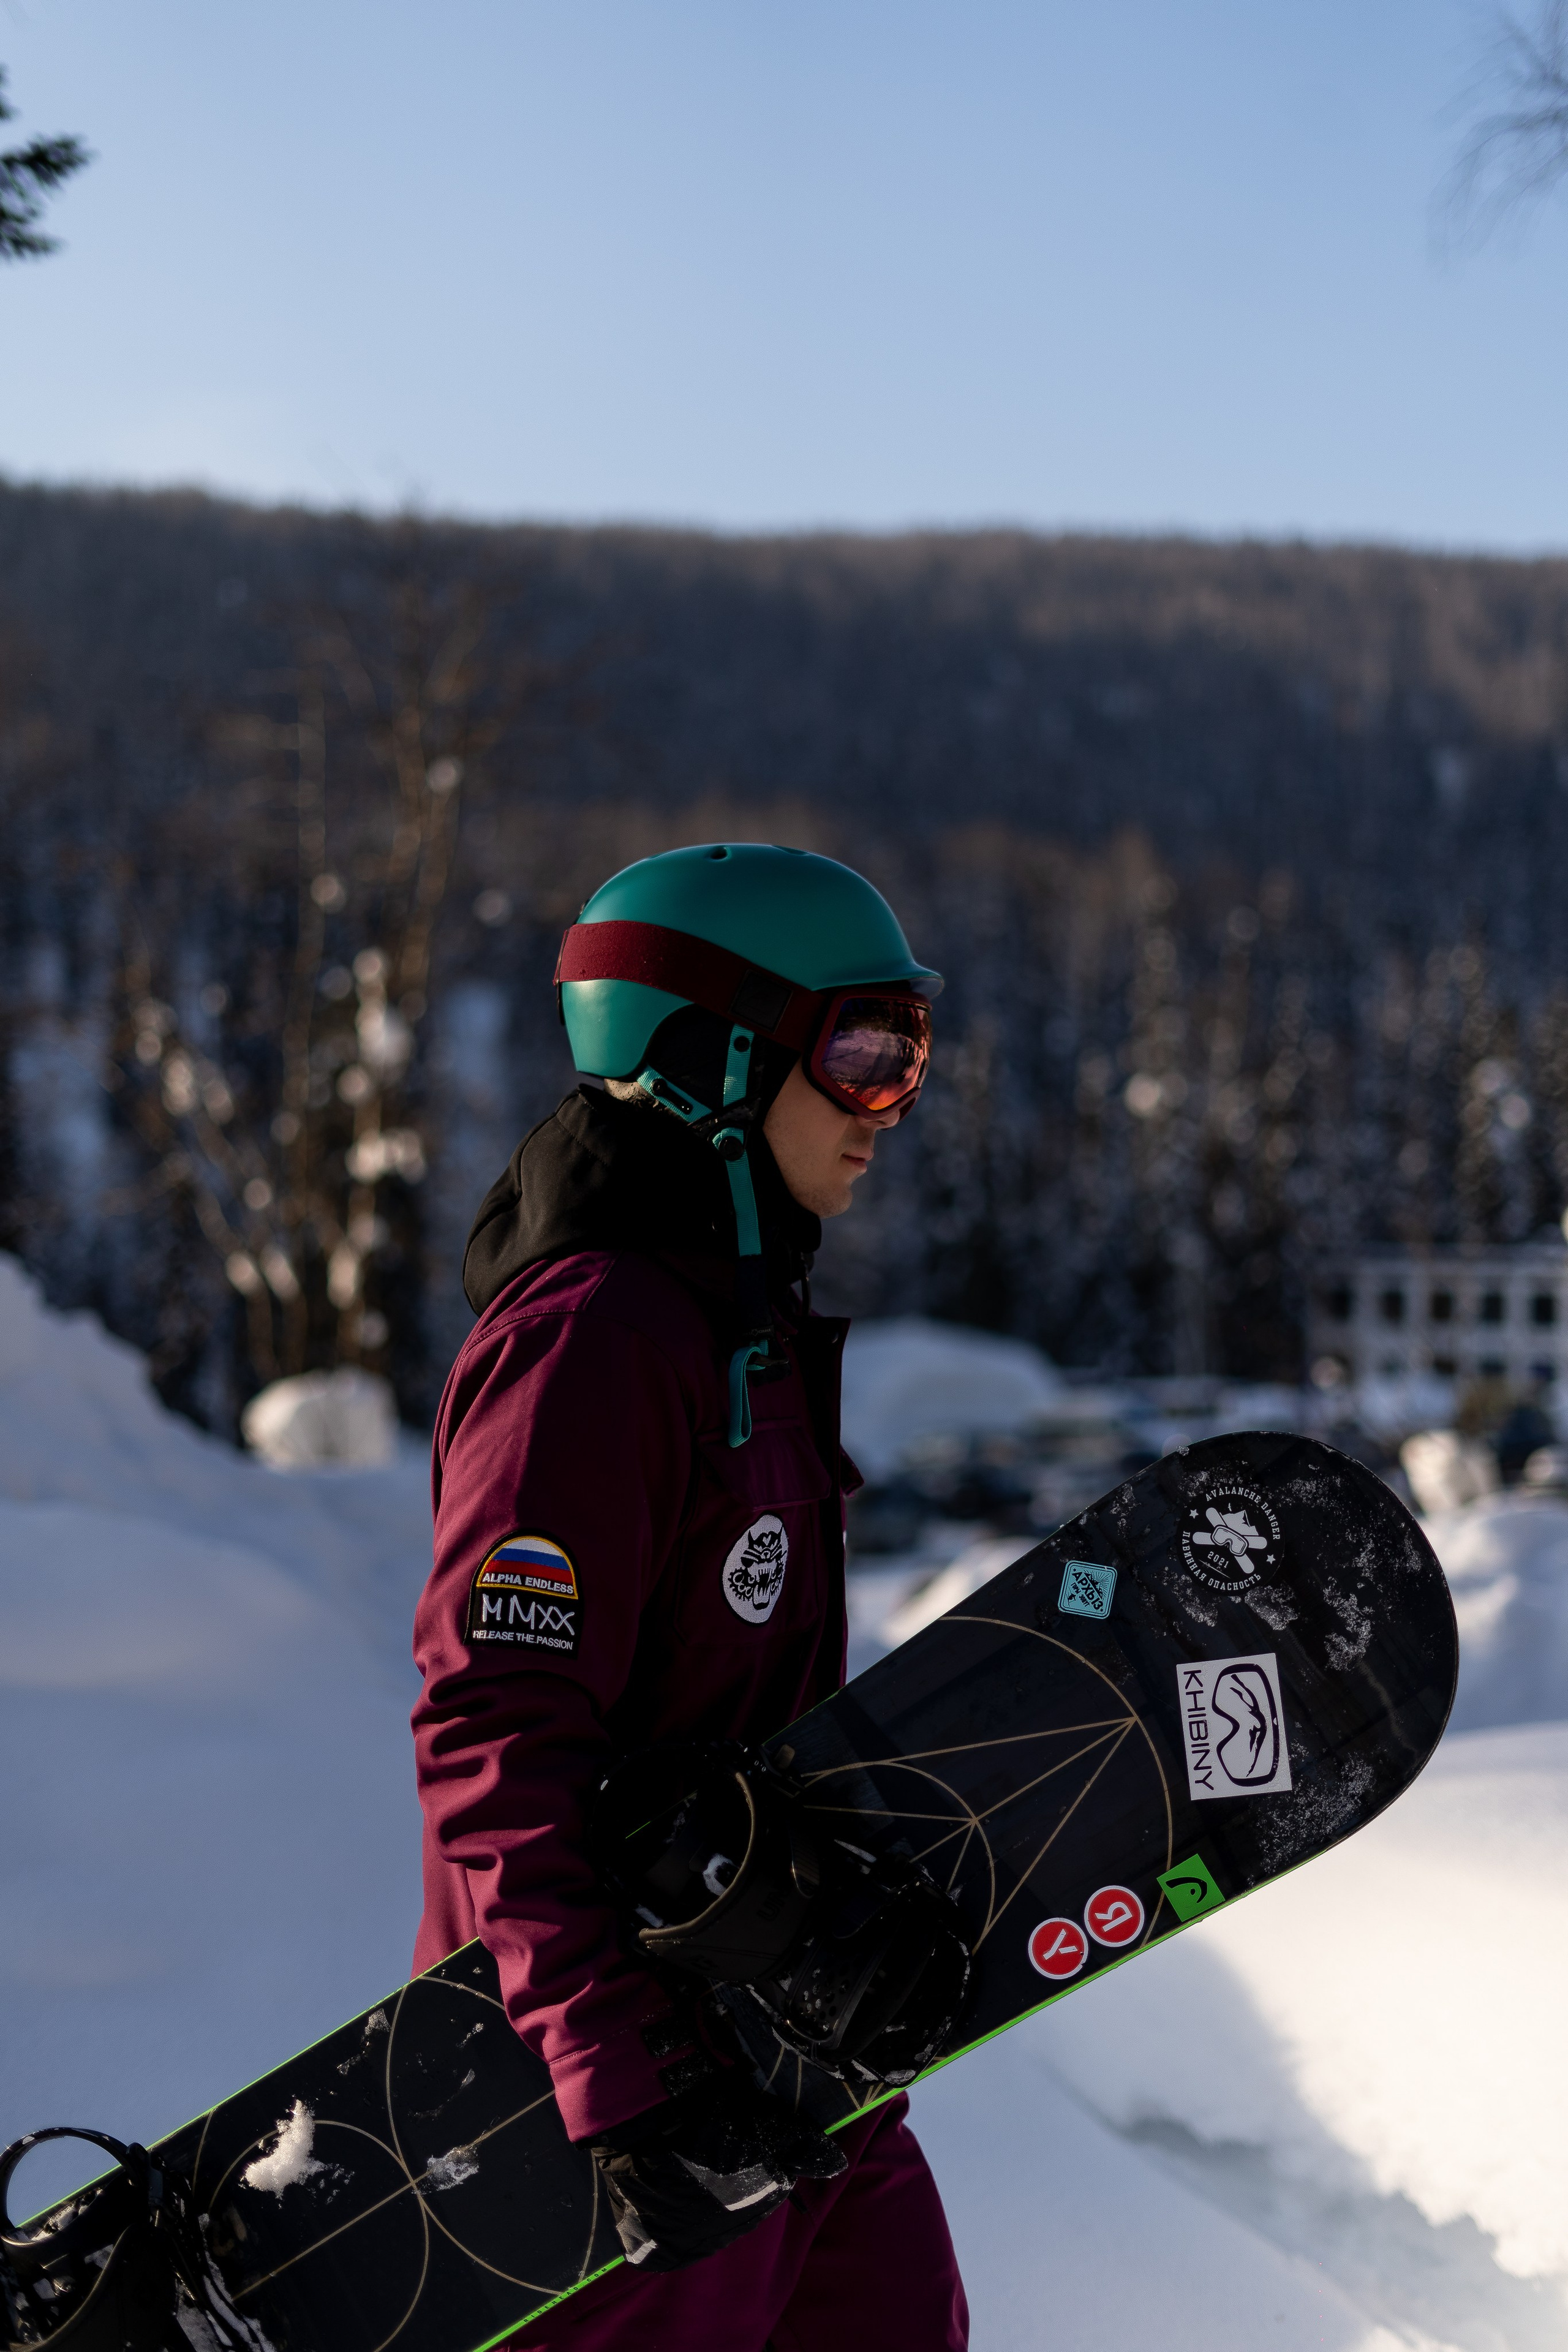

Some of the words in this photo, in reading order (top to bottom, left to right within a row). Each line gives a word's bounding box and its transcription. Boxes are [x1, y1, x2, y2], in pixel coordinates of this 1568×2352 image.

[1205, 1487, 1261, 1504] AVALANCHE
[1261, 1502, 1281, 1540] DANGER
[1182, 1531, 1207, 1581] ЛАВИННАЯ
[1207, 1573, 1261, 1591] ОПАСНОСТЬ
[1207, 1551, 1229, 1569] 2021
[482, 1572, 522, 1585] ALPHA
[525, 1575, 574, 1594] ENDLESS
[1071, 1572, 1104, 1610] АРХЫЗ
[481, 1593, 575, 1636] MMXX
[473, 1629, 514, 1641] RELEASE
[516, 1632, 535, 1643] THE
[536, 1635, 574, 1650] PASSION
[1183, 1669, 1215, 1791] KHIBINY
[523, 2267, 607, 2323] RIDEHEAD.COM
